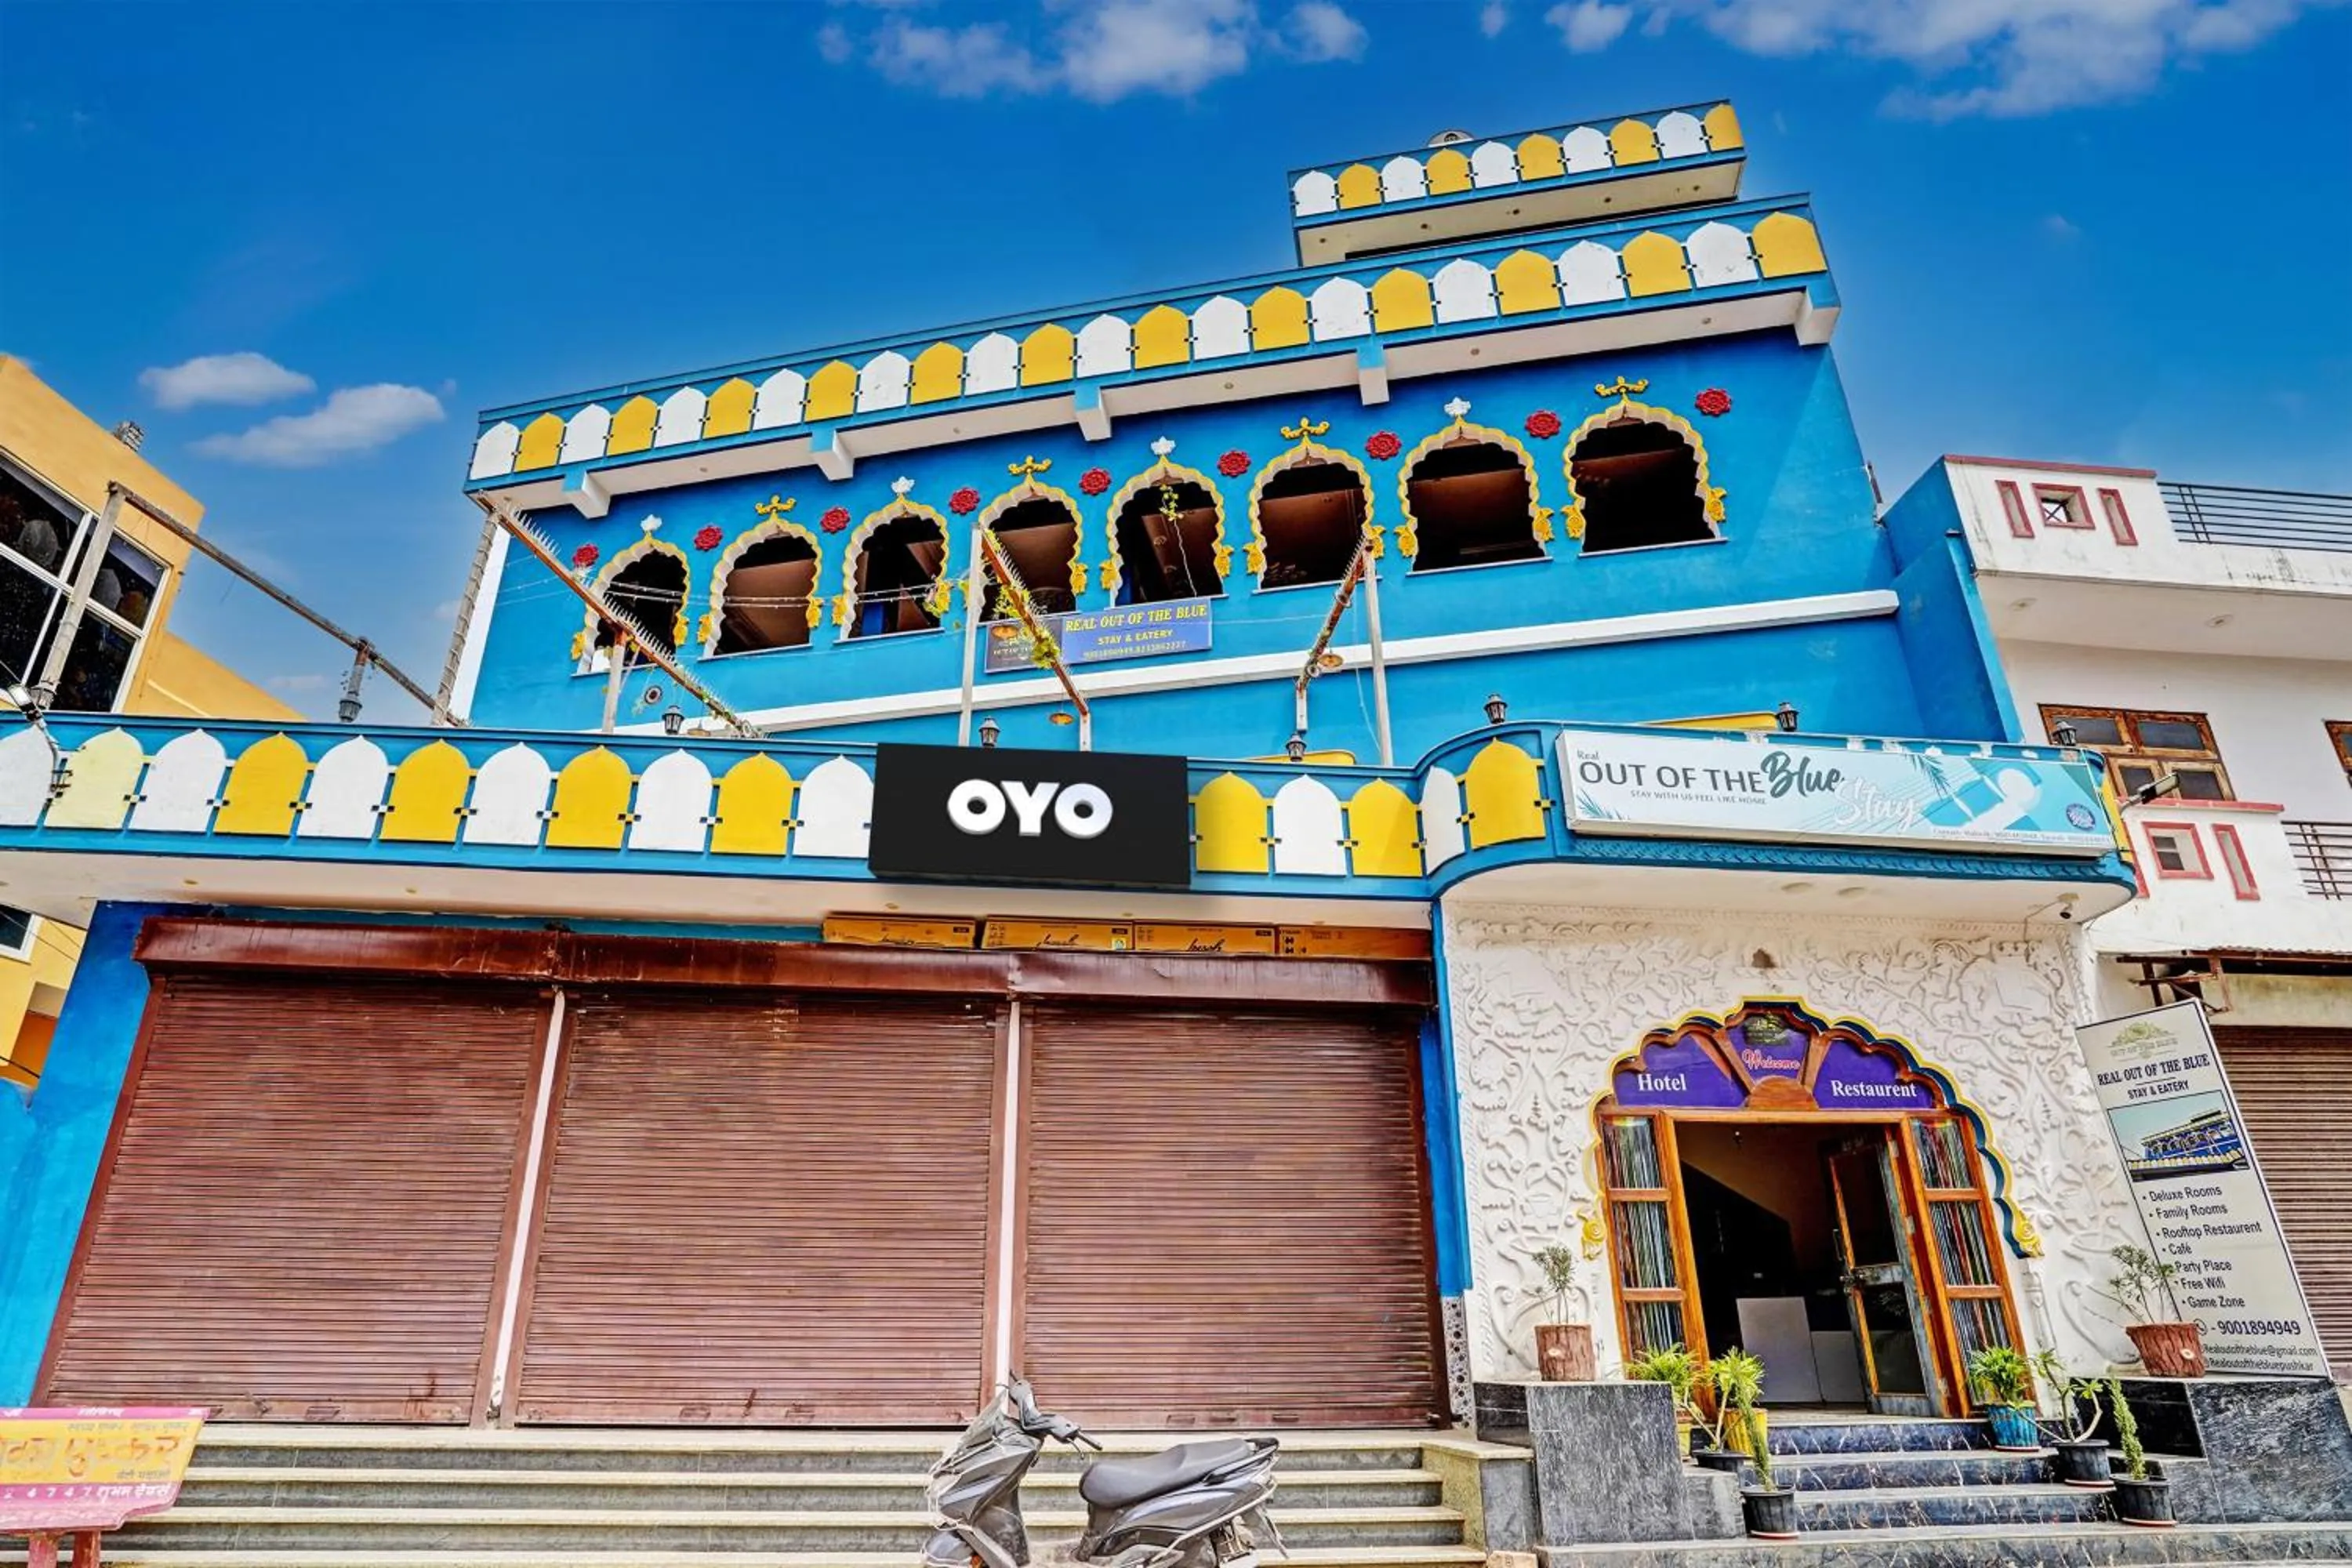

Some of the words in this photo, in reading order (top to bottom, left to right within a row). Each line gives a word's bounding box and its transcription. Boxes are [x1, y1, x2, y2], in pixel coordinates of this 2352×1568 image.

[1065, 617, 1097, 632] REAL
[1100, 614, 1124, 628] OUT
[1128, 611, 1144, 626] OF
[1147, 608, 1172, 623] THE
[1176, 604, 1207, 618] BLUE
[1098, 634, 1122, 645] STAY
[1577, 750, 1600, 760] Real
[1579, 760, 1646, 786] OUT
[1657, 765, 1697, 789] OF
[1703, 768, 1765, 793] THE
[1760, 750, 1842, 799] Blue
[1630, 789, 1652, 798] STAY
[947, 779, 1113, 839] OYO
[1832, 776, 1921, 831] Stay
[2097, 1070, 2122, 1087] REAL
[2124, 1066, 2143, 1082] OUT
[2144, 1063, 2157, 1078] OF
[2160, 1058, 2182, 1075] THE
[2183, 1054, 2210, 1071] BLUE
[1637, 1073, 1686, 1092] Hotel
[1831, 1079, 1918, 1098] Restaurent
[2127, 1086, 2148, 1099] STAY
[2156, 1080, 2189, 1096] EATERY
[2149, 1189, 2183, 1202] Deluxe
[2184, 1185, 2222, 1198] Rooms
[2155, 1206, 2189, 1220] Family
[2190, 1203, 2228, 1216] Rooms
[2161, 1225, 2202, 1240] Rooftop
[2204, 1221, 2263, 1236] Restaurent
[2175, 1260, 2201, 1275] Party
[2204, 1258, 2232, 1272] Place
[2180, 1277, 2204, 1290] Free
[2205, 1276, 2226, 1290] Wifi
[2187, 1296, 2217, 1309] Game
[2220, 1296, 2245, 1308] Zone
[2216, 1319, 2301, 1335] 9001894949
